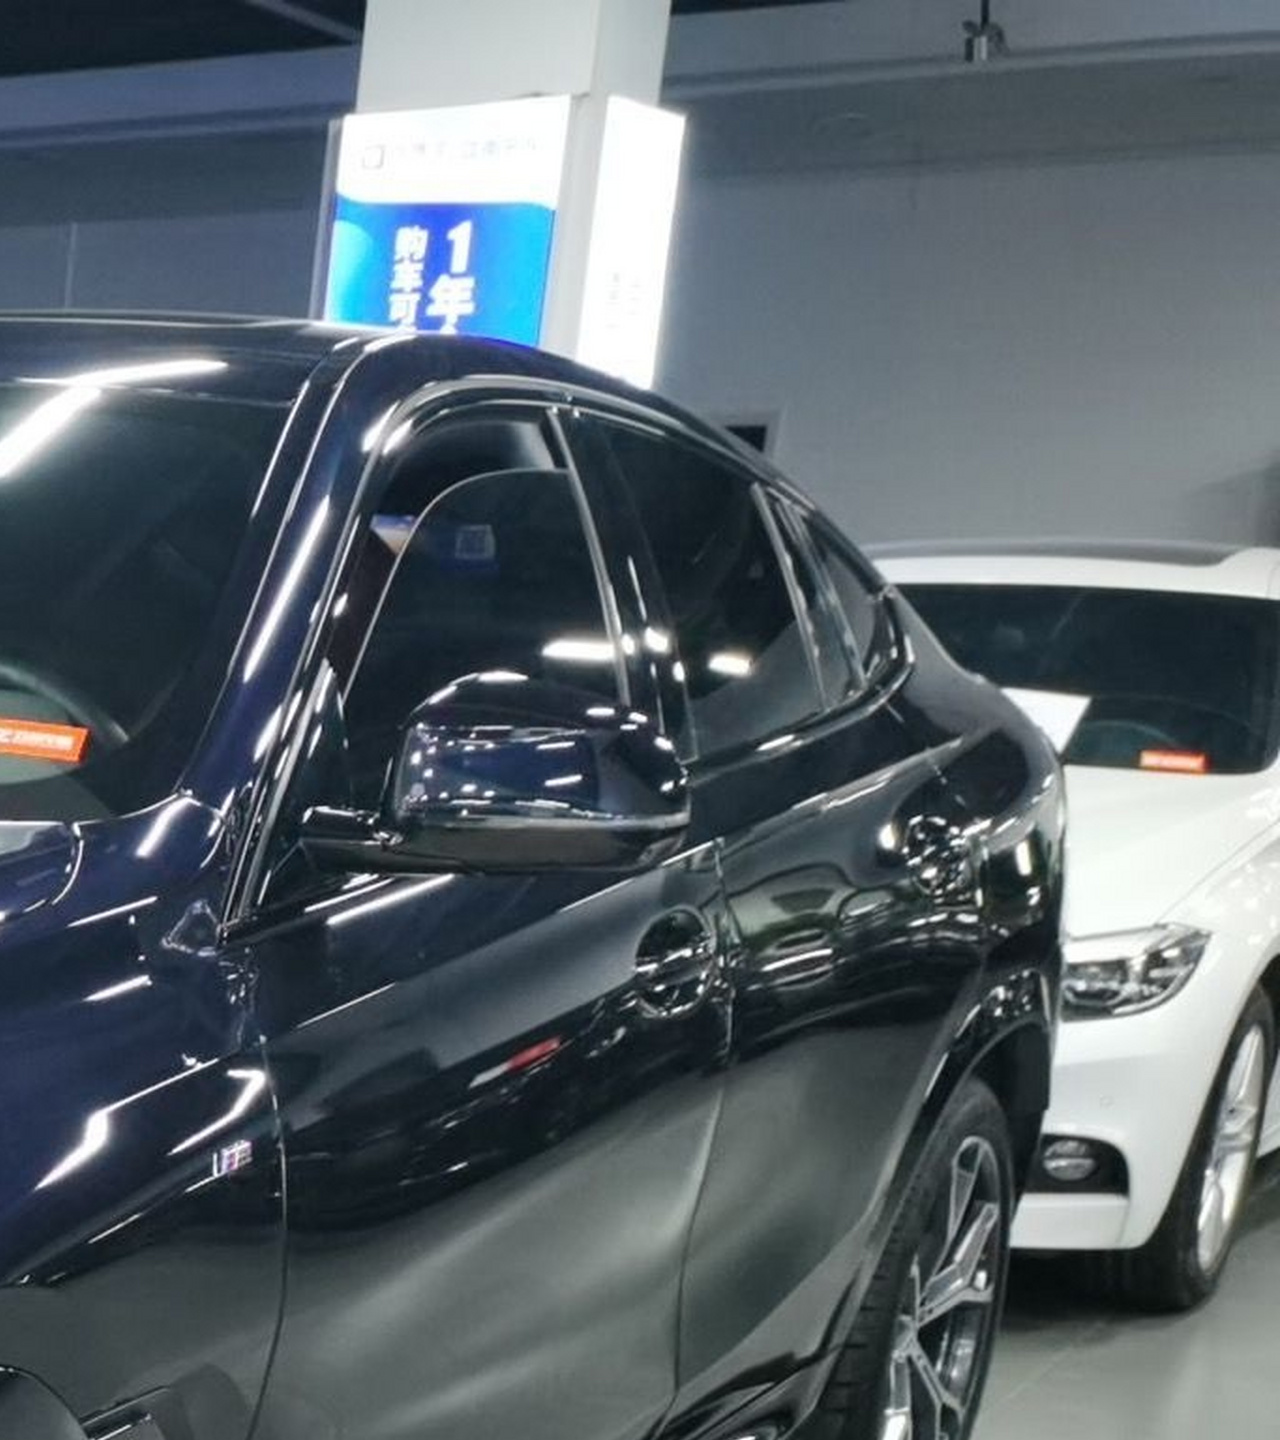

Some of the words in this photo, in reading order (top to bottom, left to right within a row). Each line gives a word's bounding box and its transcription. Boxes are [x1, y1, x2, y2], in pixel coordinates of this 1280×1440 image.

[390, 225, 428, 332] 购车可
[427, 220, 474, 334] 1年
